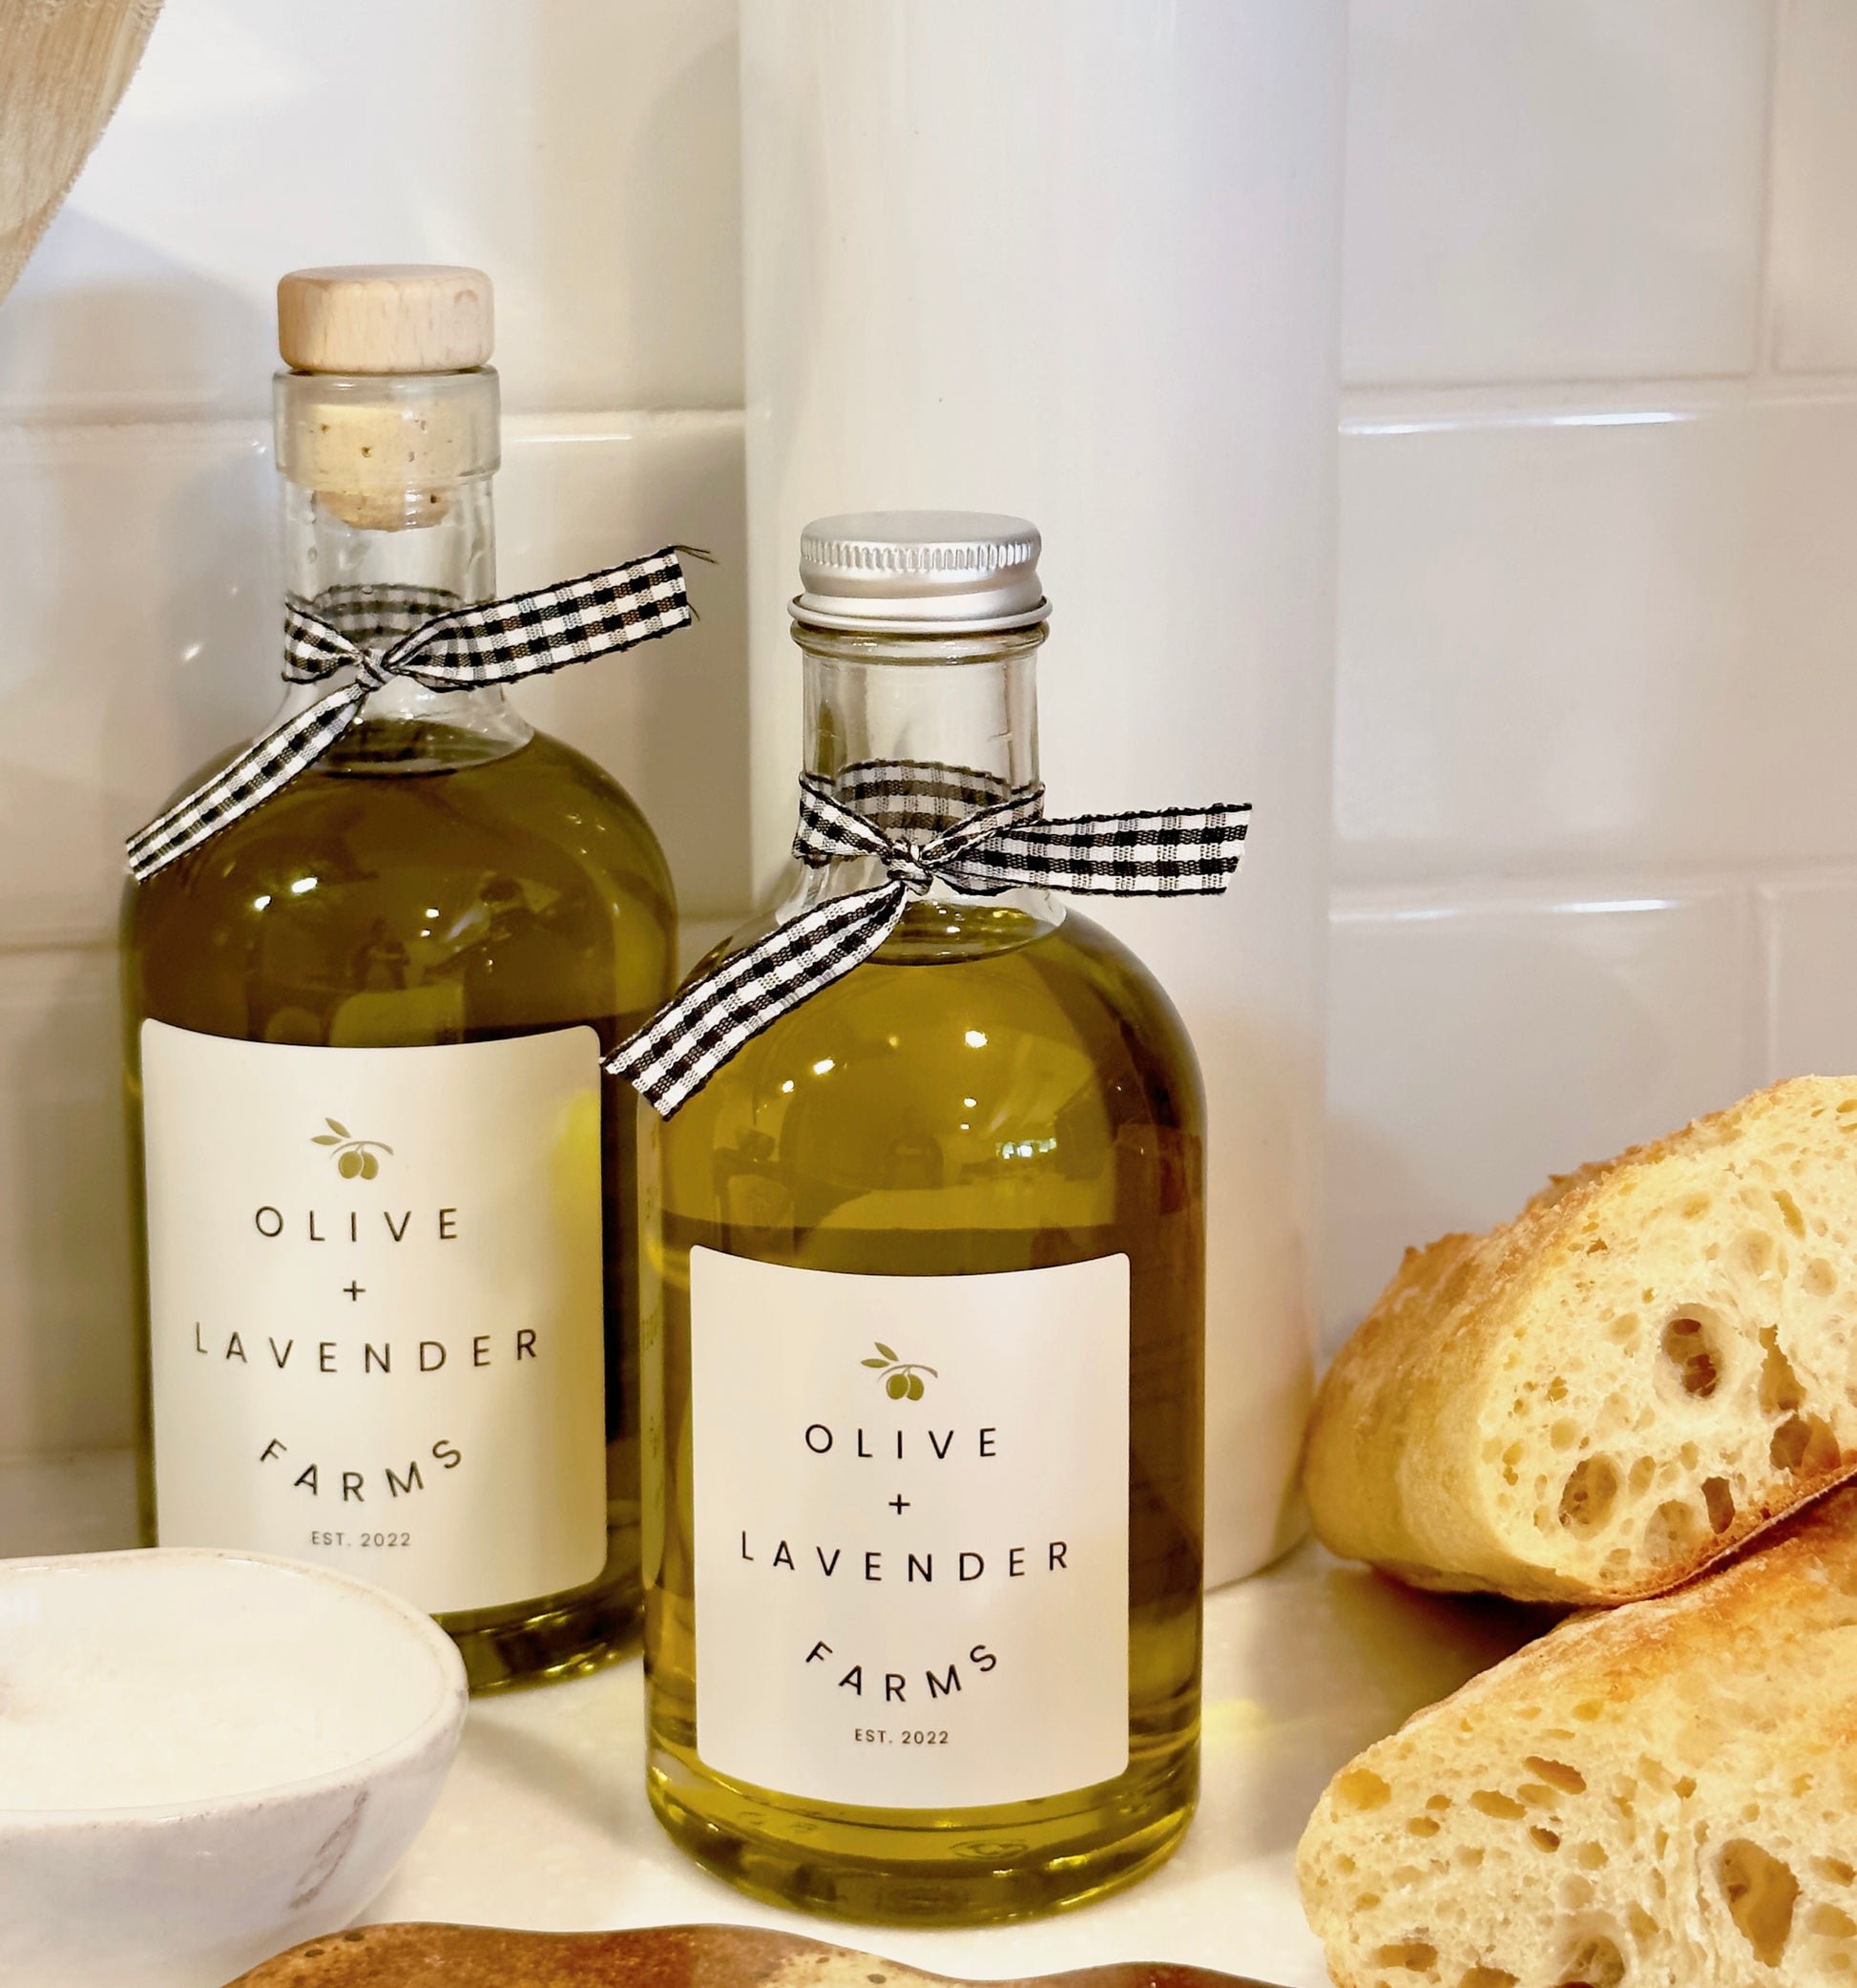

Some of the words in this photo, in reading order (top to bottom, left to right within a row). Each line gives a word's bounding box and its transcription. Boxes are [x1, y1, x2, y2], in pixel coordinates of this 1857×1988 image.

[255, 1205, 458, 1244] OLIVE
[343, 1280, 366, 1303] +
[195, 1321, 538, 1374] LAVENDER
[804, 1423, 997, 1460] OLIVE
[259, 1437, 463, 1503] FARMS
[887, 1493, 911, 1516] +
[311, 1530, 350, 1547] EST.
[361, 1532, 410, 1548] 2022
[741, 1530, 1069, 1583] LAVENDER
[804, 1640, 998, 1703] FARMS
[854, 1727, 893, 1745] EST.
[901, 1729, 949, 1746] 2022
